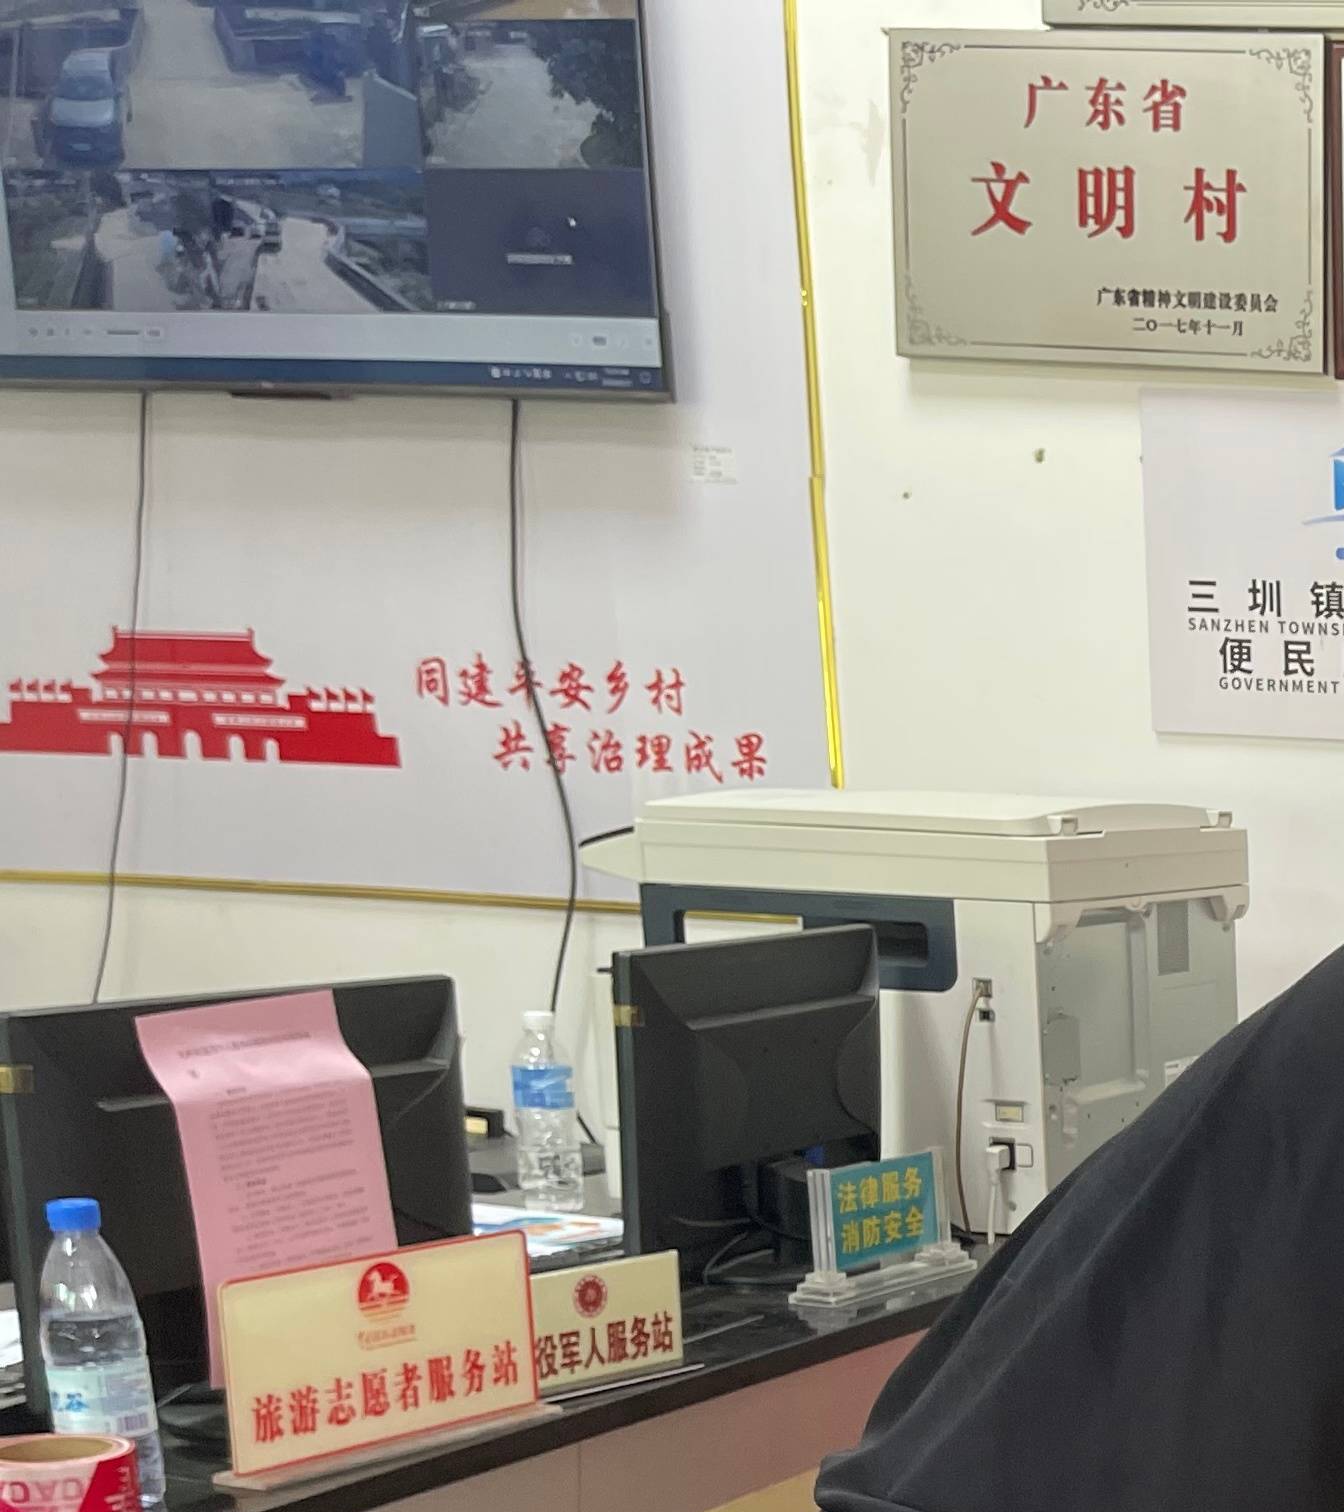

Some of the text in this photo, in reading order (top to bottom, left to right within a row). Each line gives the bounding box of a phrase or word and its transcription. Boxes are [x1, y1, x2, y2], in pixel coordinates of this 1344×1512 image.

[1023, 75, 1187, 132] 广东省
[970, 161, 1247, 244] 文明村
[1097, 287, 1278, 313] 广东省精神文明建设委员会
[1188, 617, 1269, 634] SANZHEN
[415, 651, 687, 716] 同建平安乡村
[1218, 676, 1338, 695] GOVERNMENT
[493, 718, 768, 783] 共享治理成果
[837, 1167, 922, 1214] 法律服务
[841, 1205, 924, 1254] 消防安全
[536, 1310, 673, 1380] 役军人服务站
[252, 1340, 518, 1444] 旅游志愿者服务站
